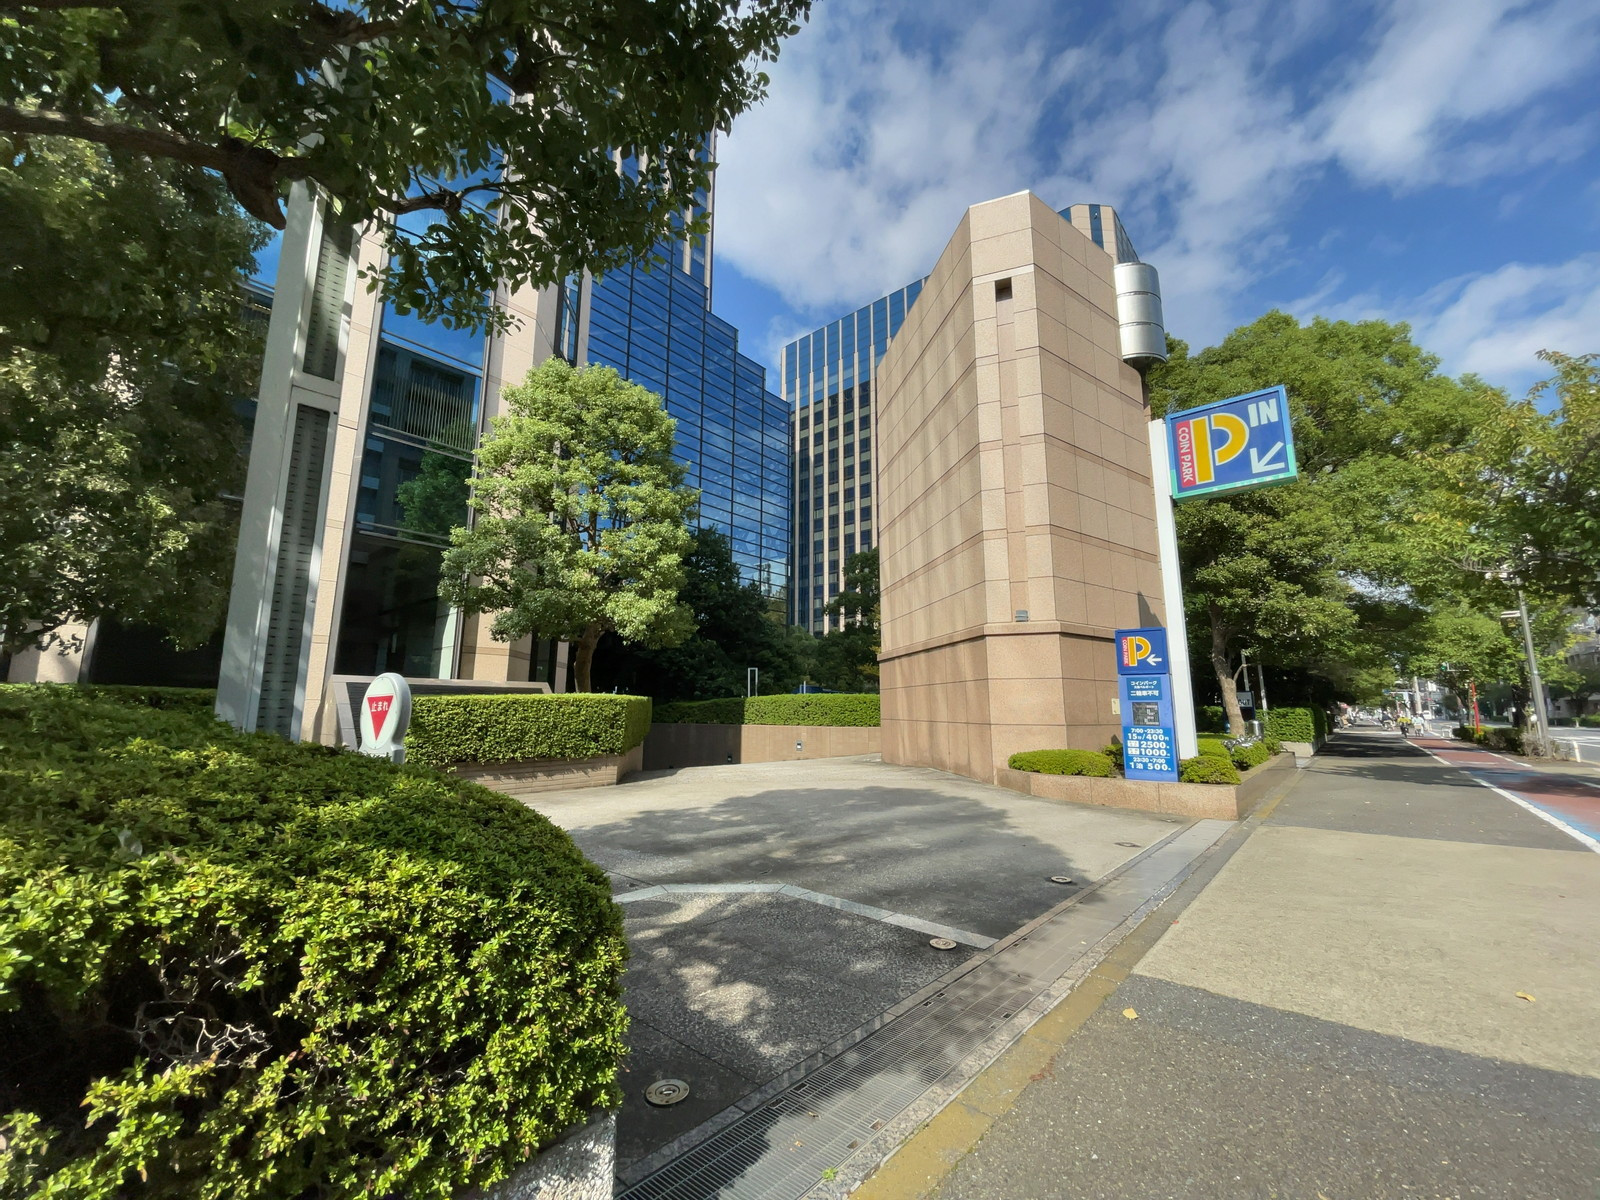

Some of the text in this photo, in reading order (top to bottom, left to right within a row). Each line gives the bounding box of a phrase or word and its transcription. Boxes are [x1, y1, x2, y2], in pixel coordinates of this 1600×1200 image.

[1248, 398, 1279, 427] IN
[1178, 427, 1194, 483] COIN PARK
[1189, 412, 1250, 485] P
[1127, 636, 1151, 667] P
[371, 701, 389, 712] 止まれ
